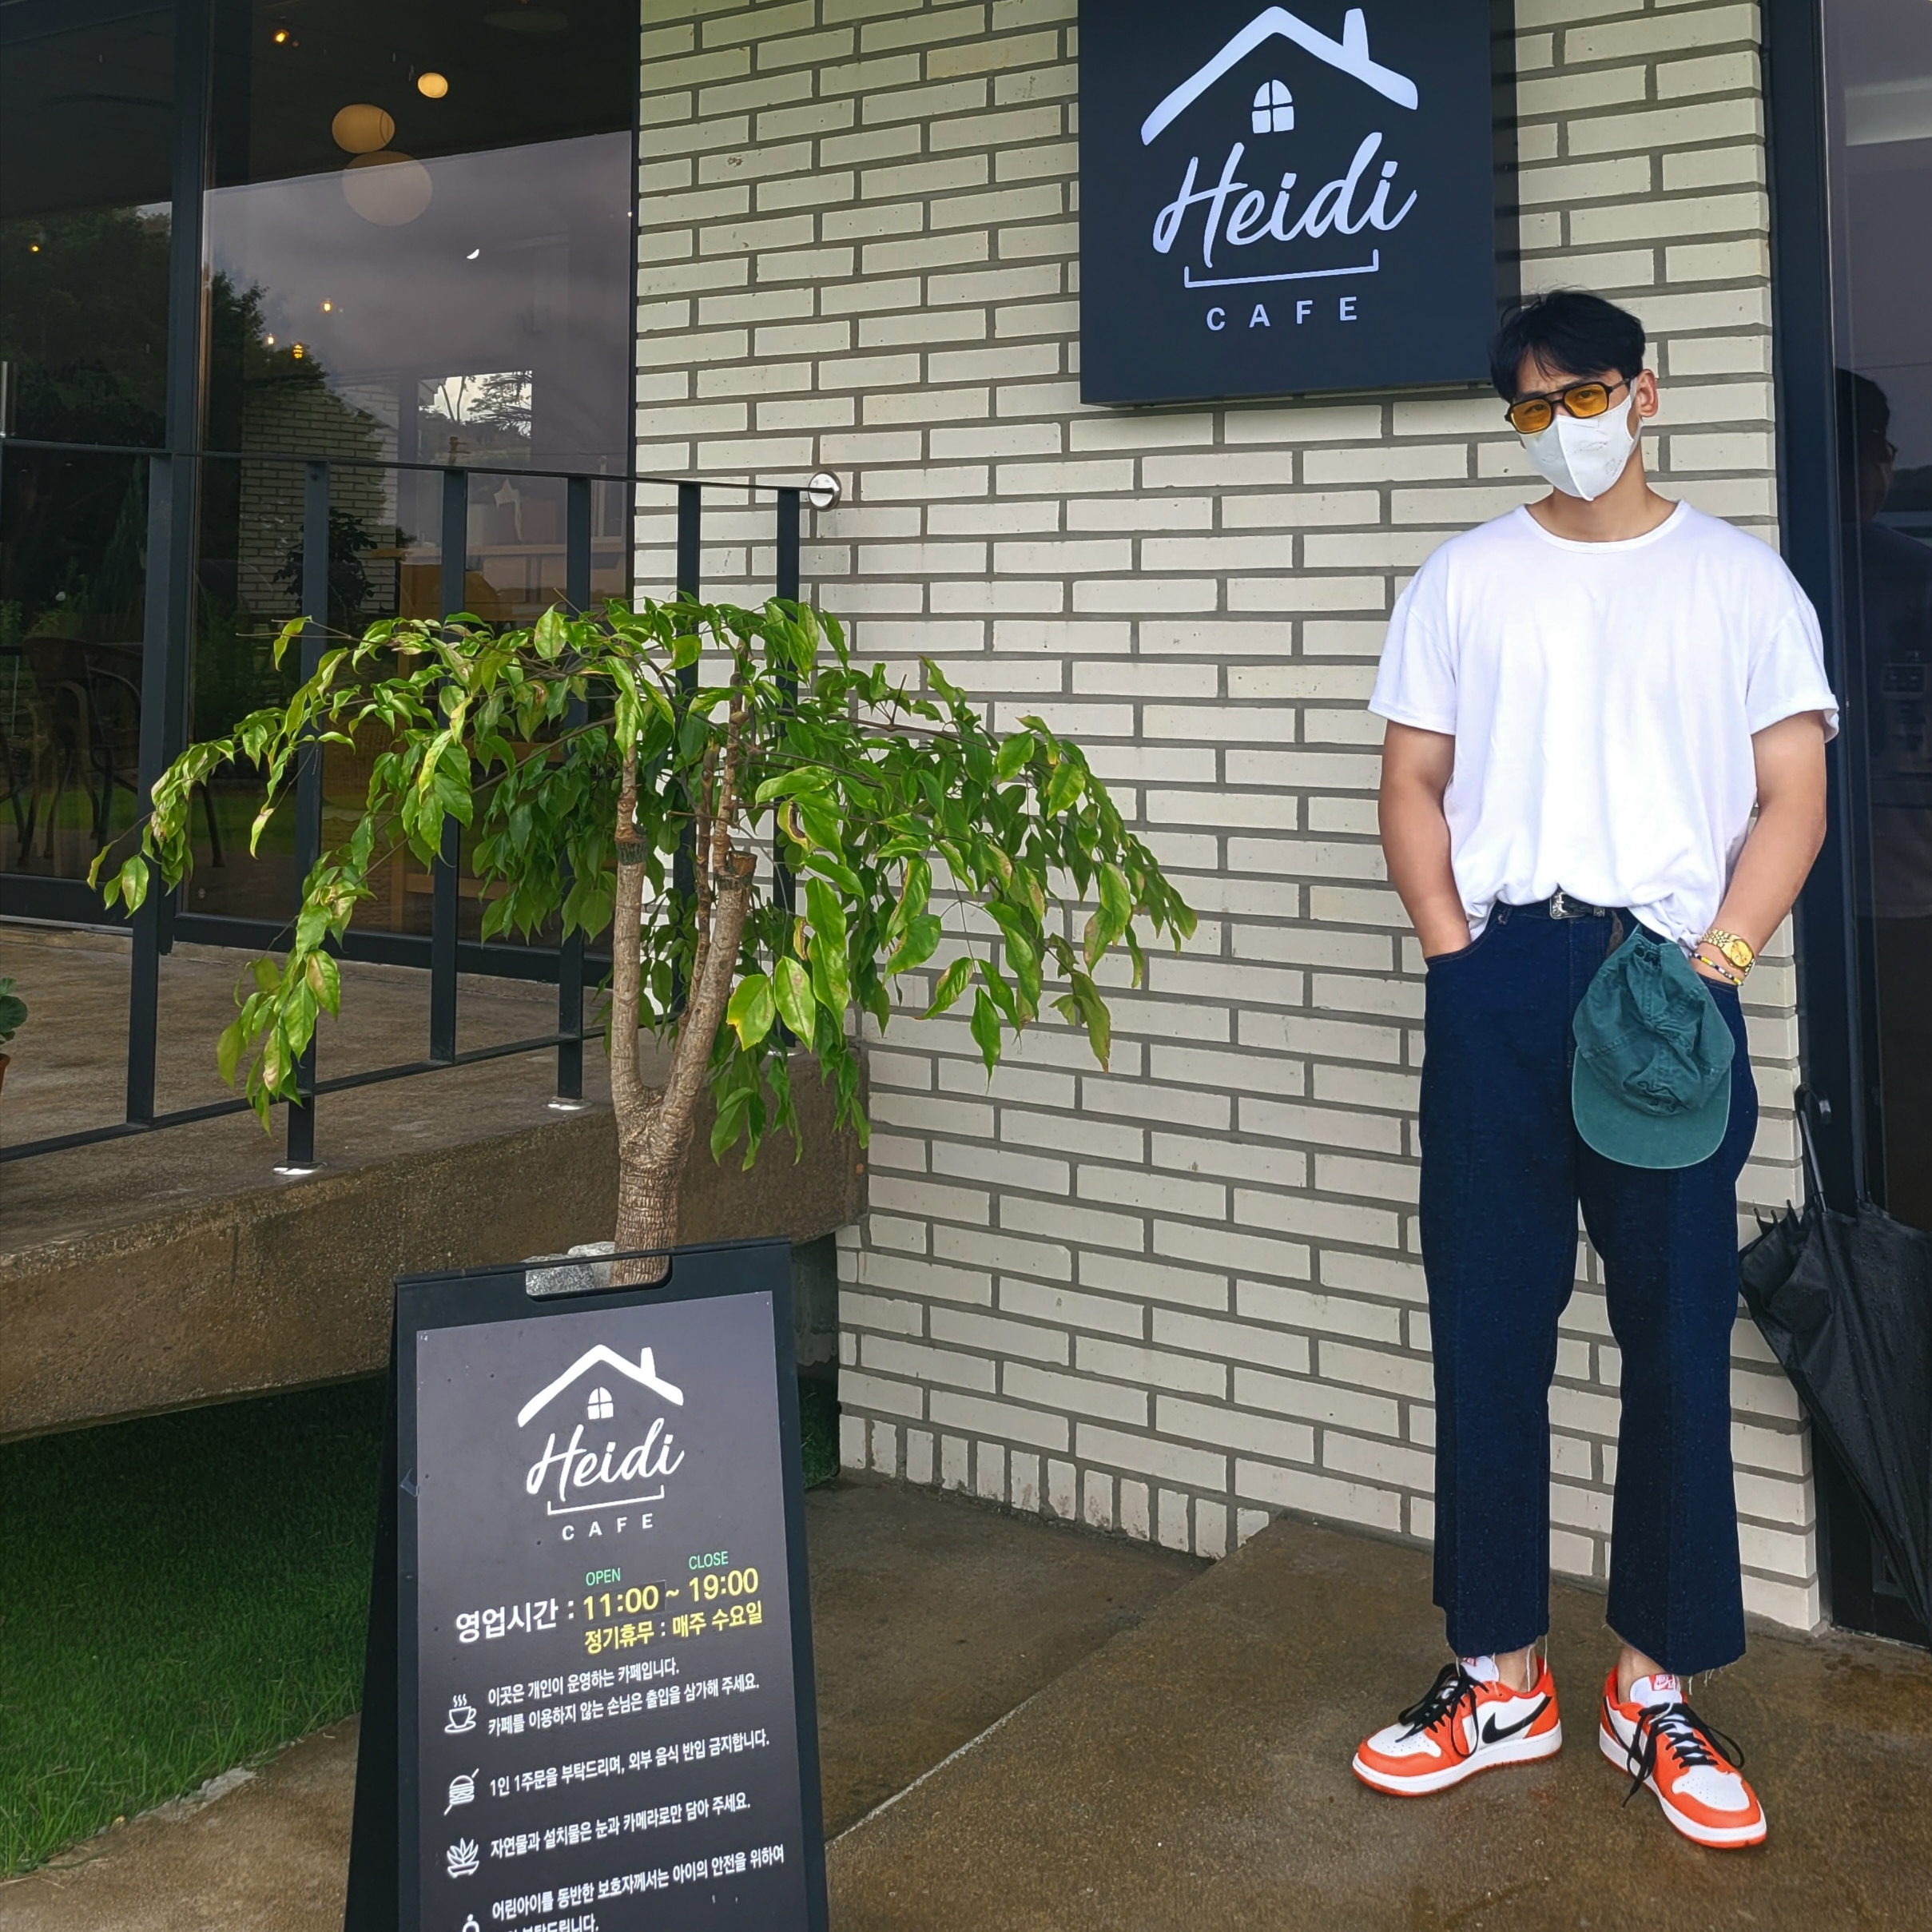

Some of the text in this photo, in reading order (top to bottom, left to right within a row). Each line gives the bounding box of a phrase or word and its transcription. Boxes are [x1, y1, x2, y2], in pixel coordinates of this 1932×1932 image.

[1152, 132, 1417, 268] Heidi
[1206, 296, 1358, 331] CAFE
[526, 1417, 685, 1502] Heidi
[562, 1513, 654, 1540] CAFE
[585, 1551, 729, 1586] OPEN CLOSE
[455, 1598, 559, 1644] 영업시간
[582, 1585, 659, 1620] 11:00
[688, 1568, 759, 1602] 19:00
[584, 1620, 655, 1655] 정기휴무
[672, 1612, 707, 1638] 매주
[711, 1600, 763, 1632] 수요일
[487, 1656, 680, 1707] 이곳은 개인이 운영하는 카페입니다.
[488, 1672, 760, 1737] 카페를 이용하지 않는 손님은 출입을 삼가해 주세요.
[490, 1727, 770, 1797] 1인 1주문을 부탁드리며, 외부 음식 반입 금지합니다.
[490, 1791, 751, 1859] 자연물과 설치물은 눈과 카메라로만 담아 주세요.
[491, 1843, 785, 1922] 어린아이를 동반한 보호자께서는 아이의 안전을 위하여
